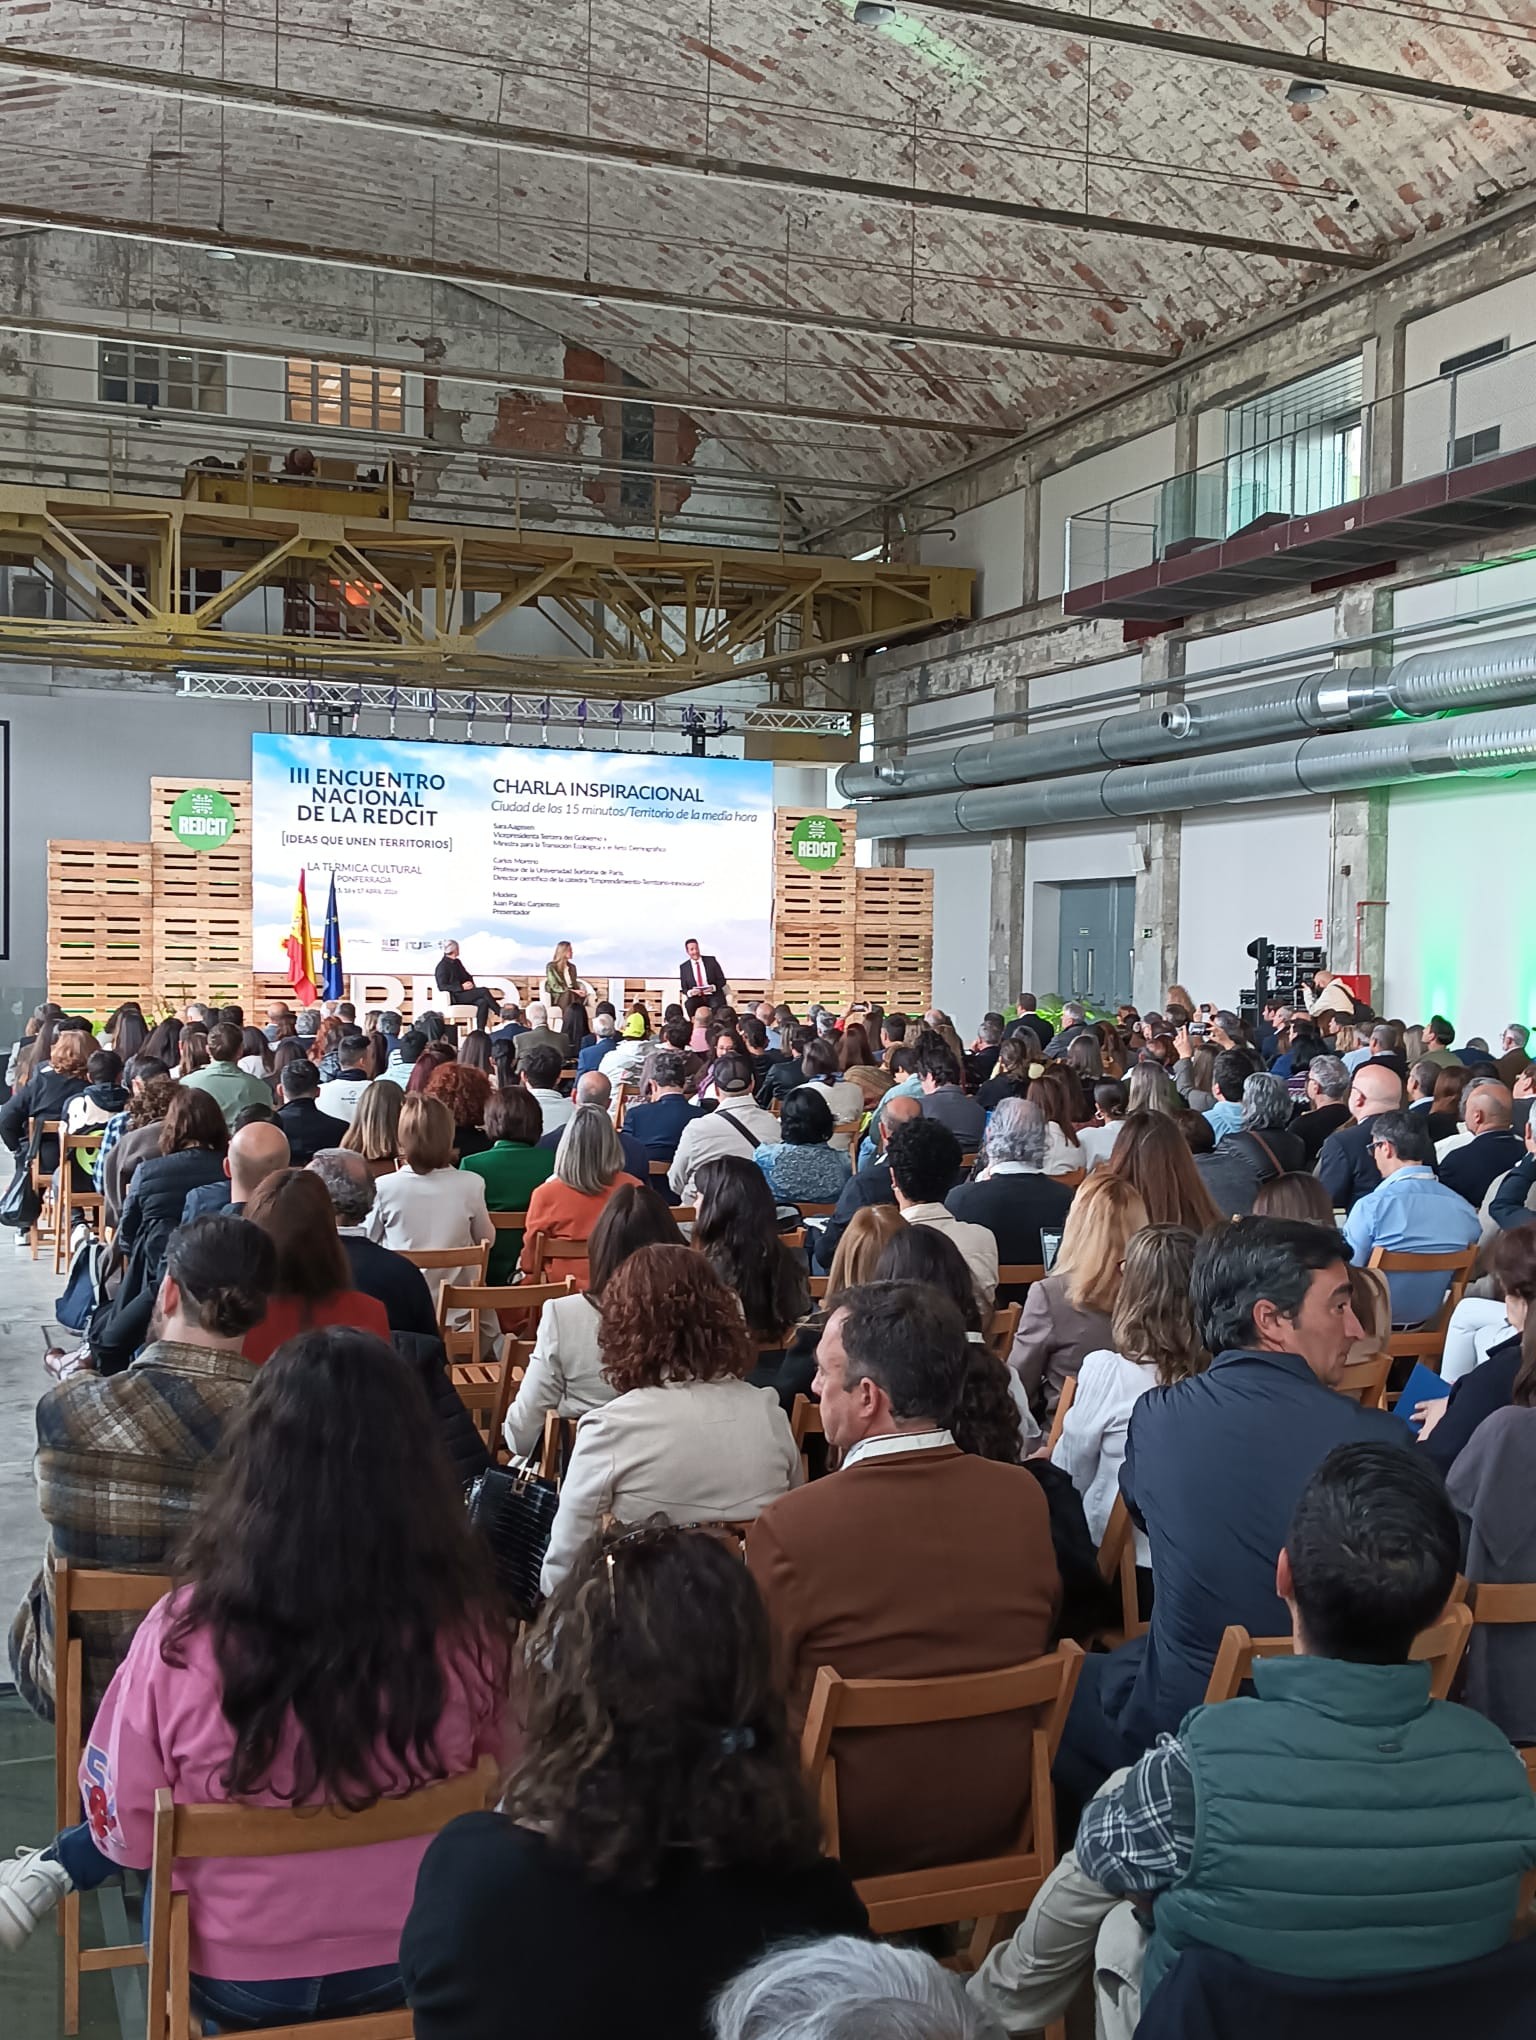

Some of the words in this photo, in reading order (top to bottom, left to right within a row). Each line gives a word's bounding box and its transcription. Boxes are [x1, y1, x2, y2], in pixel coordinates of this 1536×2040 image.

[289, 767, 310, 784] III
[316, 768, 446, 791] ENCUENTRO
[311, 787, 425, 808] NACIONAL
[493, 778, 568, 796] CHARLA
[570, 782, 705, 803] INSPIRACIONAL
[297, 805, 325, 822] DE
[330, 806, 357, 824] LA
[363, 808, 439, 827] REDCIT
[491, 800, 531, 813] Ciudad
[532, 803, 546, 813] de
[547, 803, 562, 814] los
[565, 803, 580, 815] 15
[582, 806, 675, 820] minutos/Territorio
[676, 809, 689, 820] de
[690, 809, 701, 820] la
[702, 811, 733, 822] media
[735, 811, 758, 823] hora
[178, 815, 229, 837] REDCIT
[281, 830, 319, 847] [IDEAS
[320, 835, 343, 847] QUE
[346, 836, 377, 847] UNEN
[379, 837, 453, 853] TERRITORIOS]
[798, 840, 838, 858] REDCIT
[306, 862, 320, 871] LA
[370, 864, 423, 875] CULTURAL
[336, 875, 391, 884] PONFERRADA
